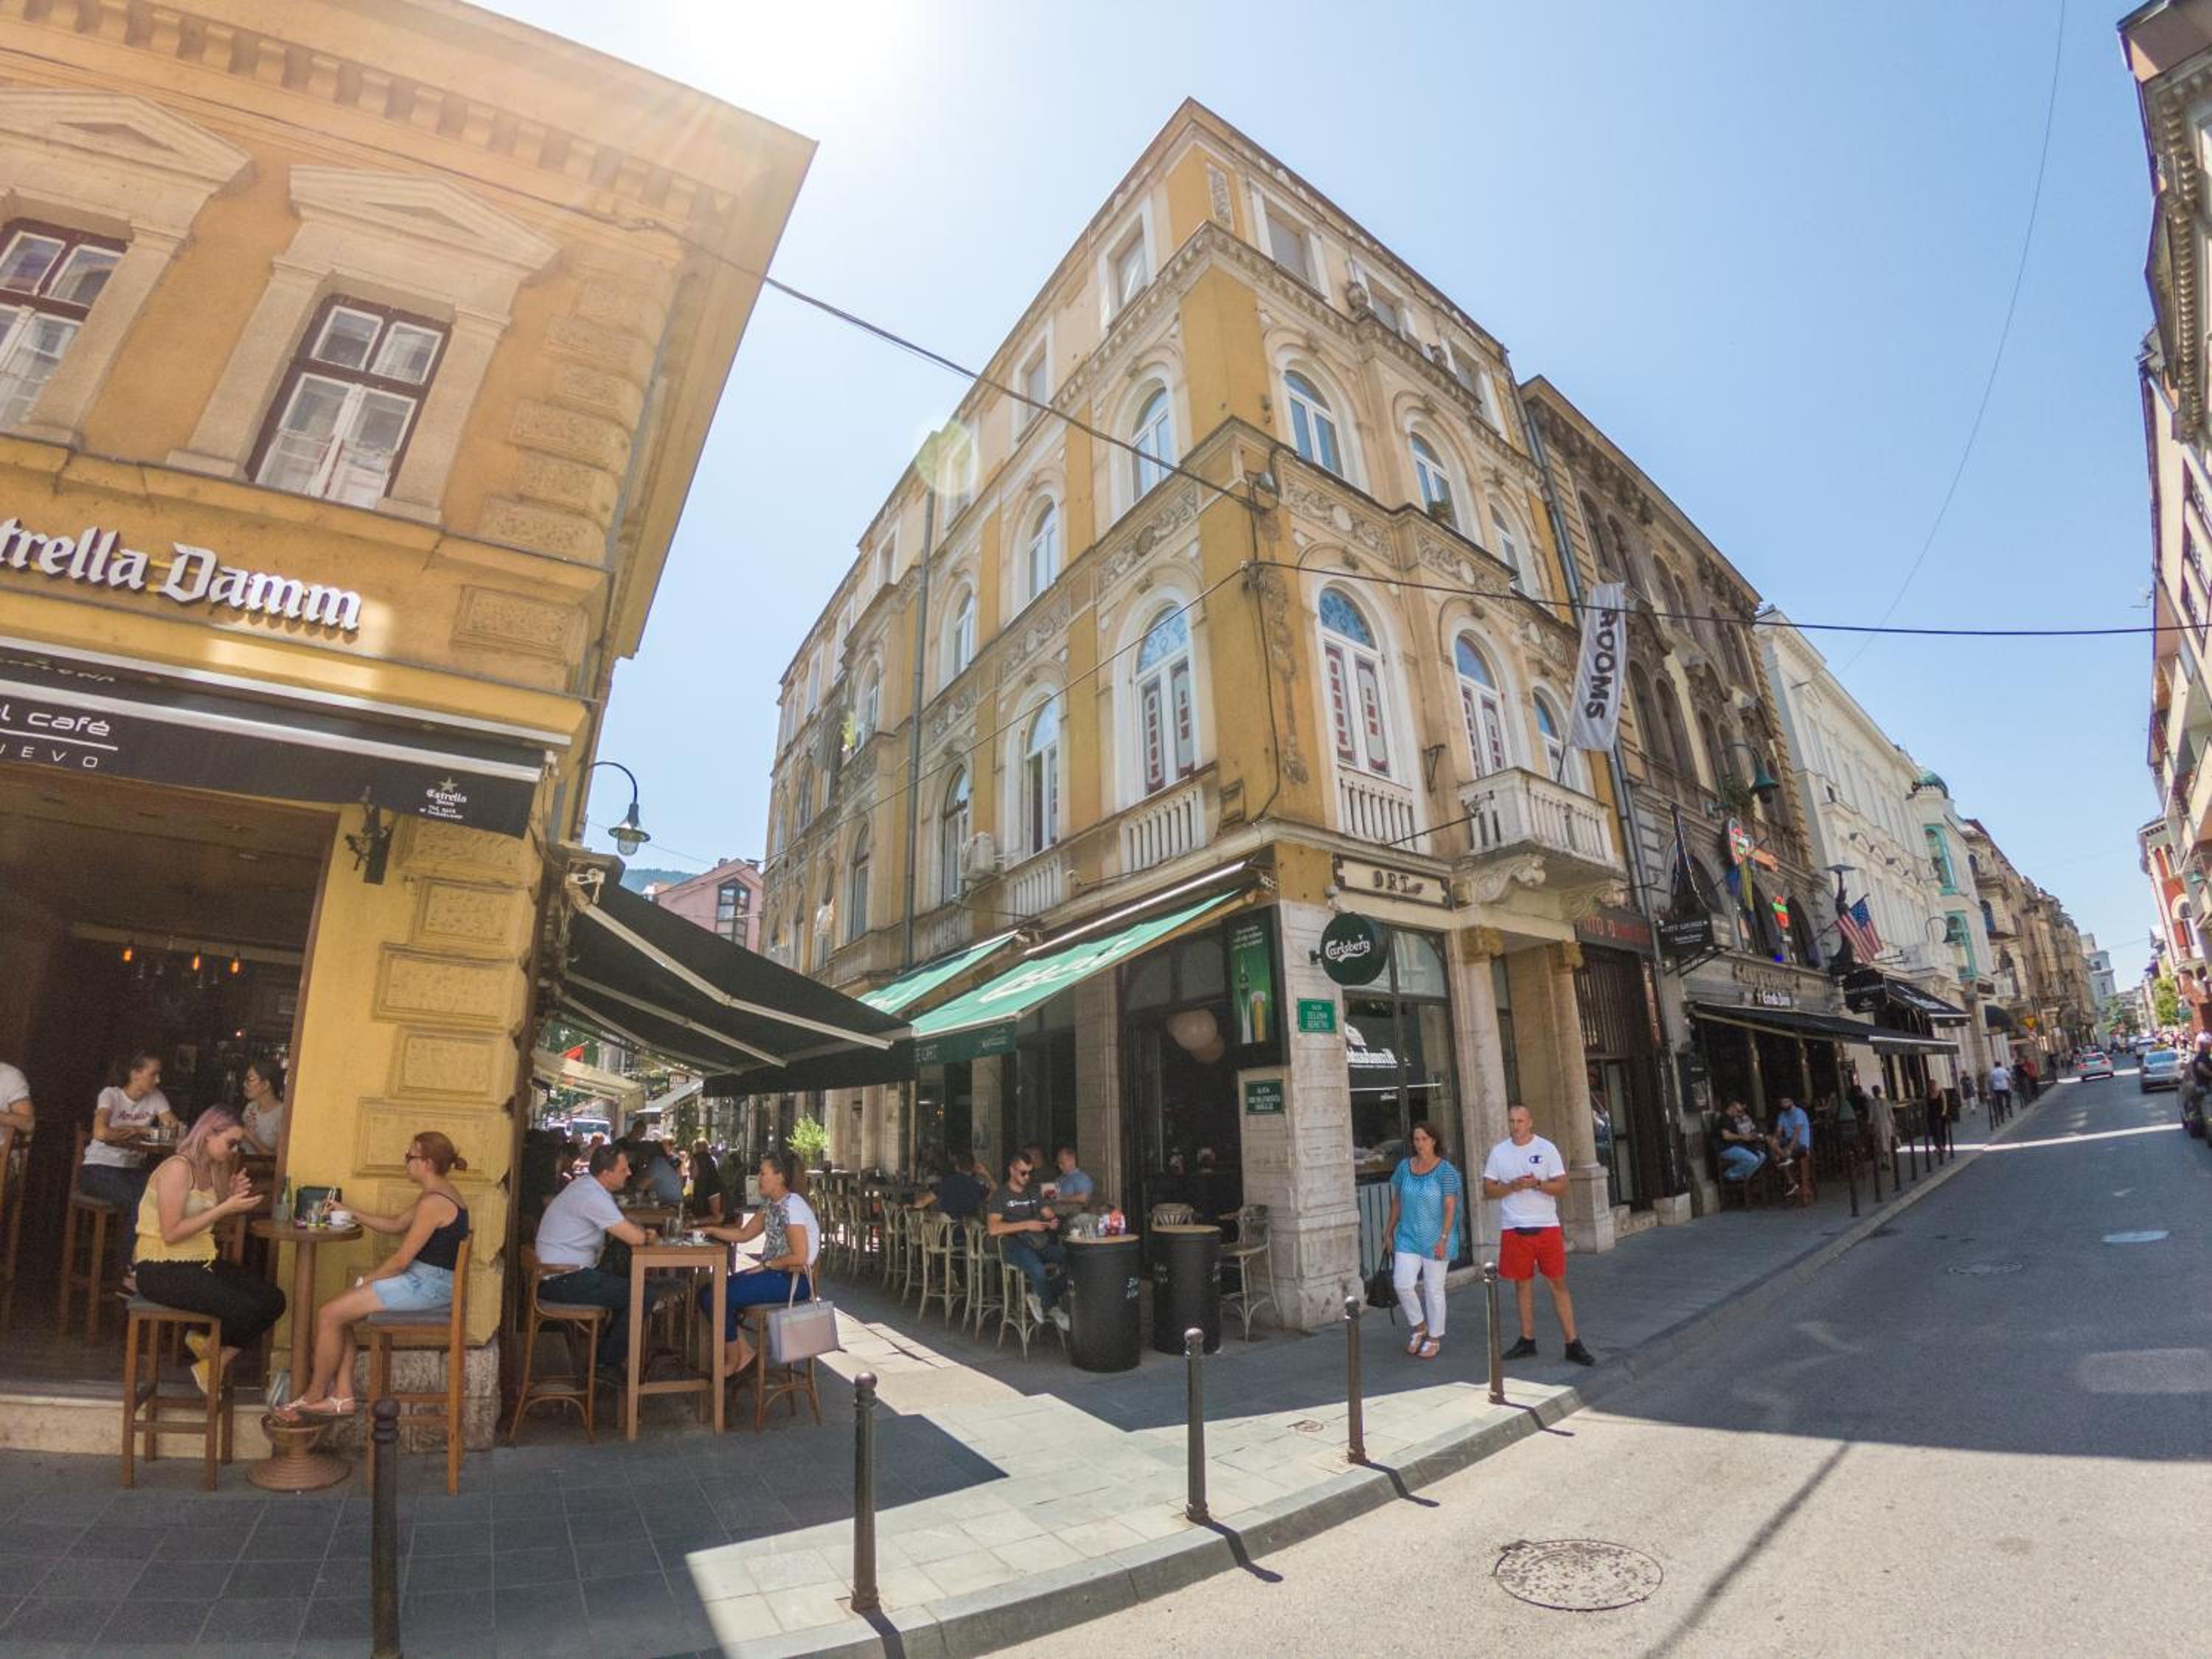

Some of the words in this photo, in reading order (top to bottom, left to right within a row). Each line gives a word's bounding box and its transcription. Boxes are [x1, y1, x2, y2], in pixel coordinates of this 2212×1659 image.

[159, 542, 362, 630] Damm
[1585, 608, 1618, 720] ROOMS
[27, 711, 111, 737] café
[425, 789, 467, 804] Estrella
[1325, 933, 1371, 963] Carlsberg
